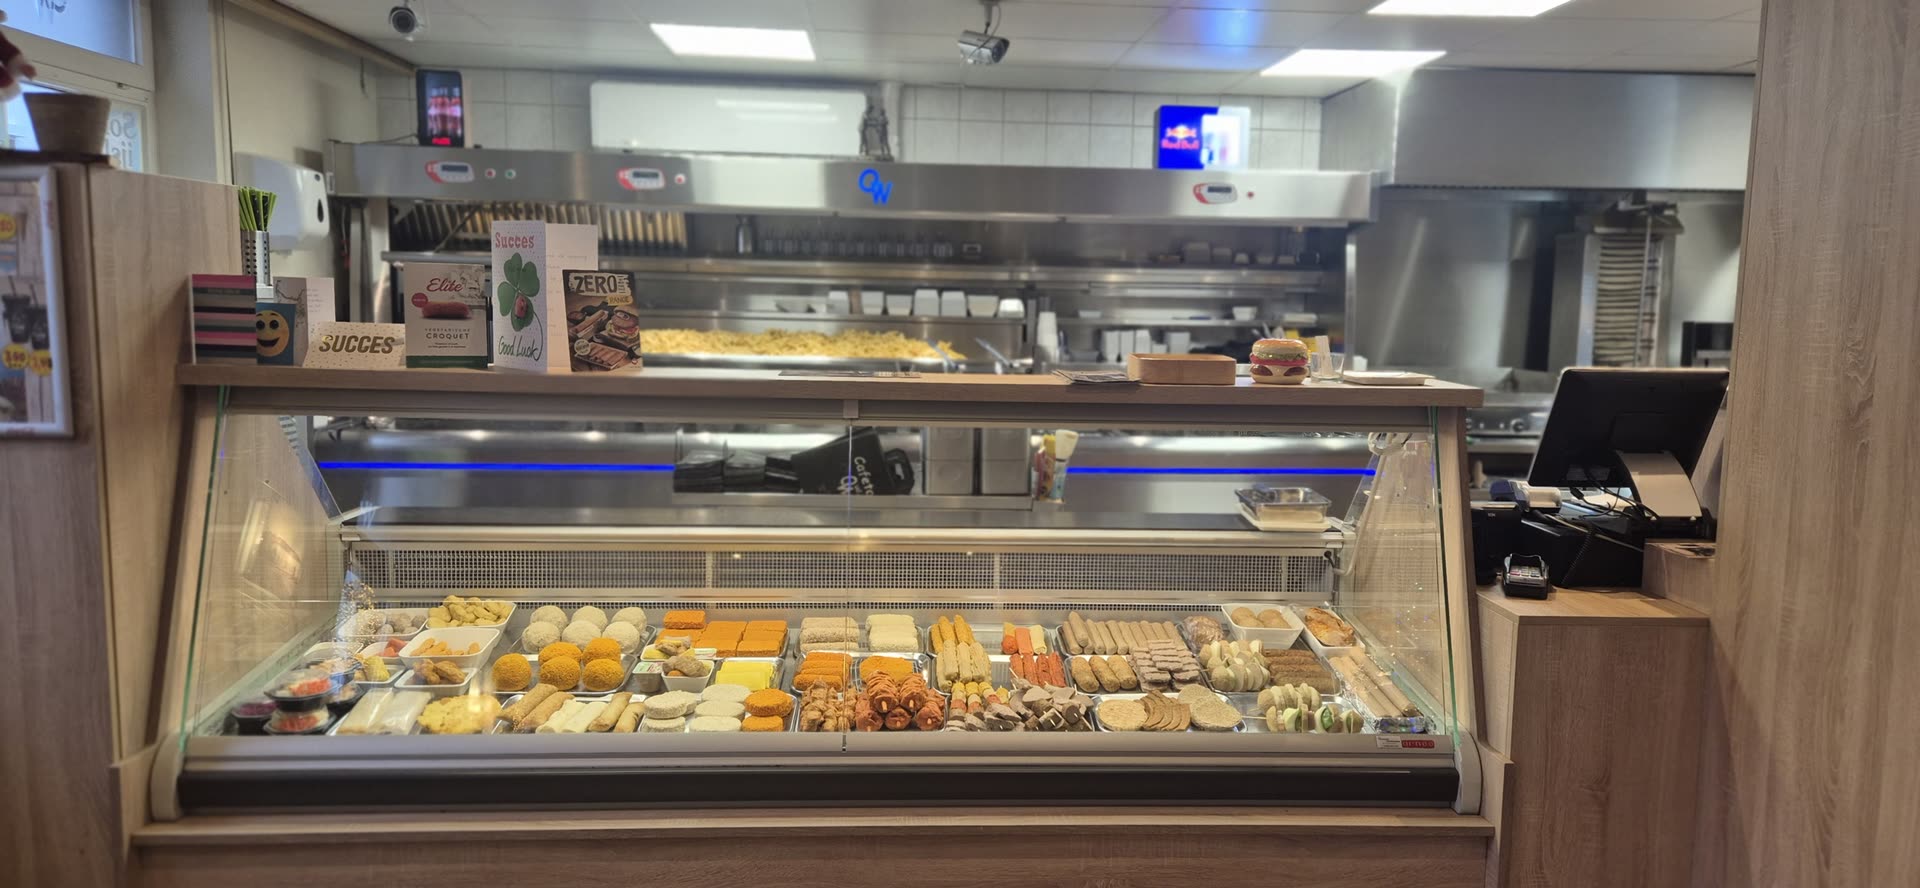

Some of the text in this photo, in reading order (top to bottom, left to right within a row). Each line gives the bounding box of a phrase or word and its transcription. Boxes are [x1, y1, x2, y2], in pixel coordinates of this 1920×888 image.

[495, 232, 535, 249] Succes
[426, 278, 463, 292] Elite
[574, 275, 617, 294] ZERO
[319, 335, 396, 354] SUCCES
[499, 335, 539, 360] Good Luck
